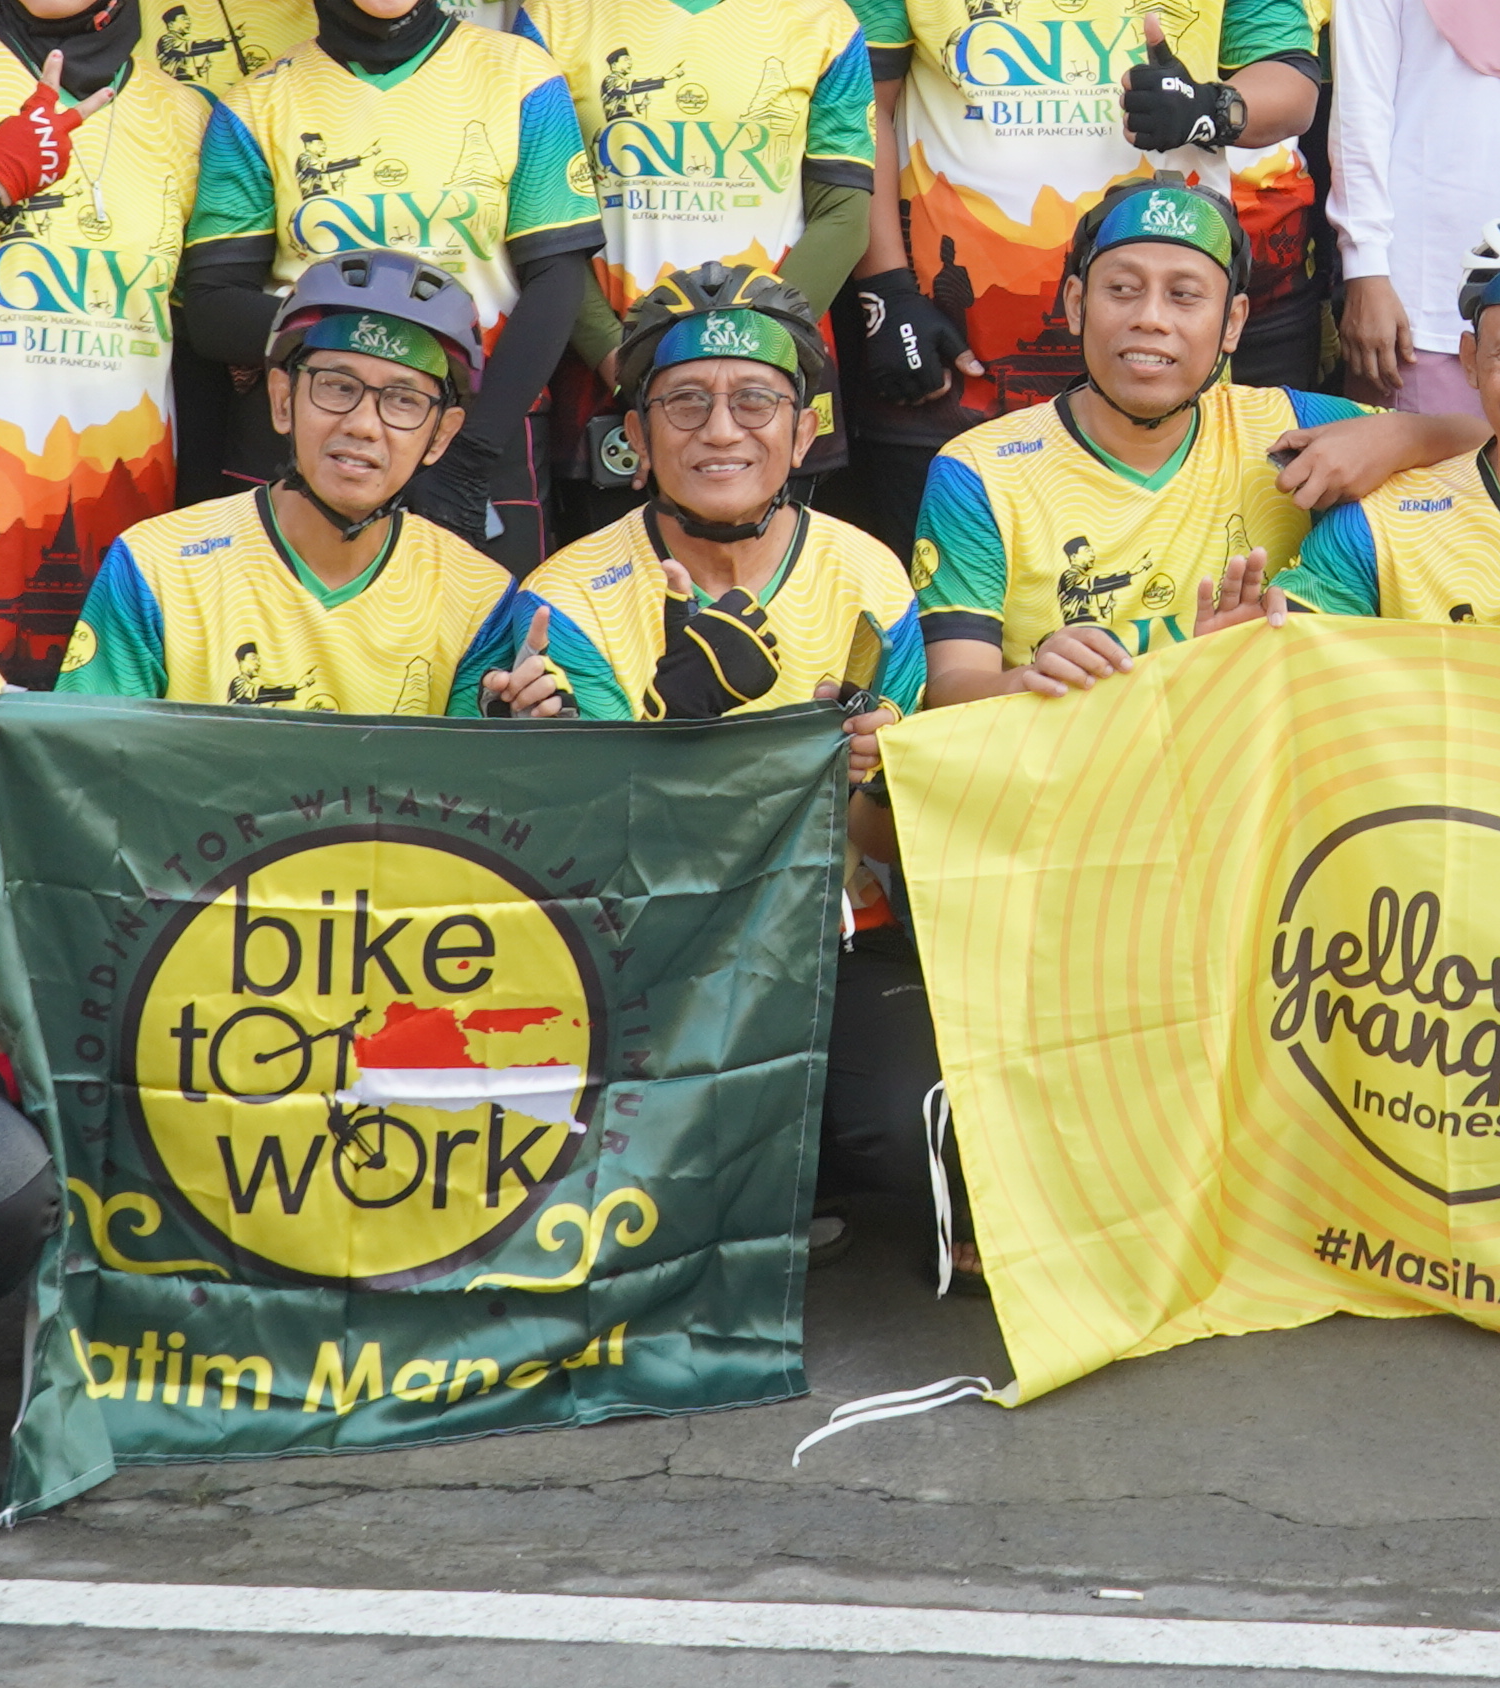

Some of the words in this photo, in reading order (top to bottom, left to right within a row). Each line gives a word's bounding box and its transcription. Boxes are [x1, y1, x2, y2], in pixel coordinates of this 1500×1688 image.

[988, 98, 1117, 126] BLITAR
[995, 126, 1036, 138] BLITAR
[1038, 126, 1084, 138] PANCEN
[626, 187, 727, 212] BLITAR
[22, 325, 126, 359] BLITAR
[290, 783, 532, 851] WILAYAH
[232, 876, 496, 997] bike
[214, 1100, 554, 1216] work
[71, 1328, 274, 1411] atim
